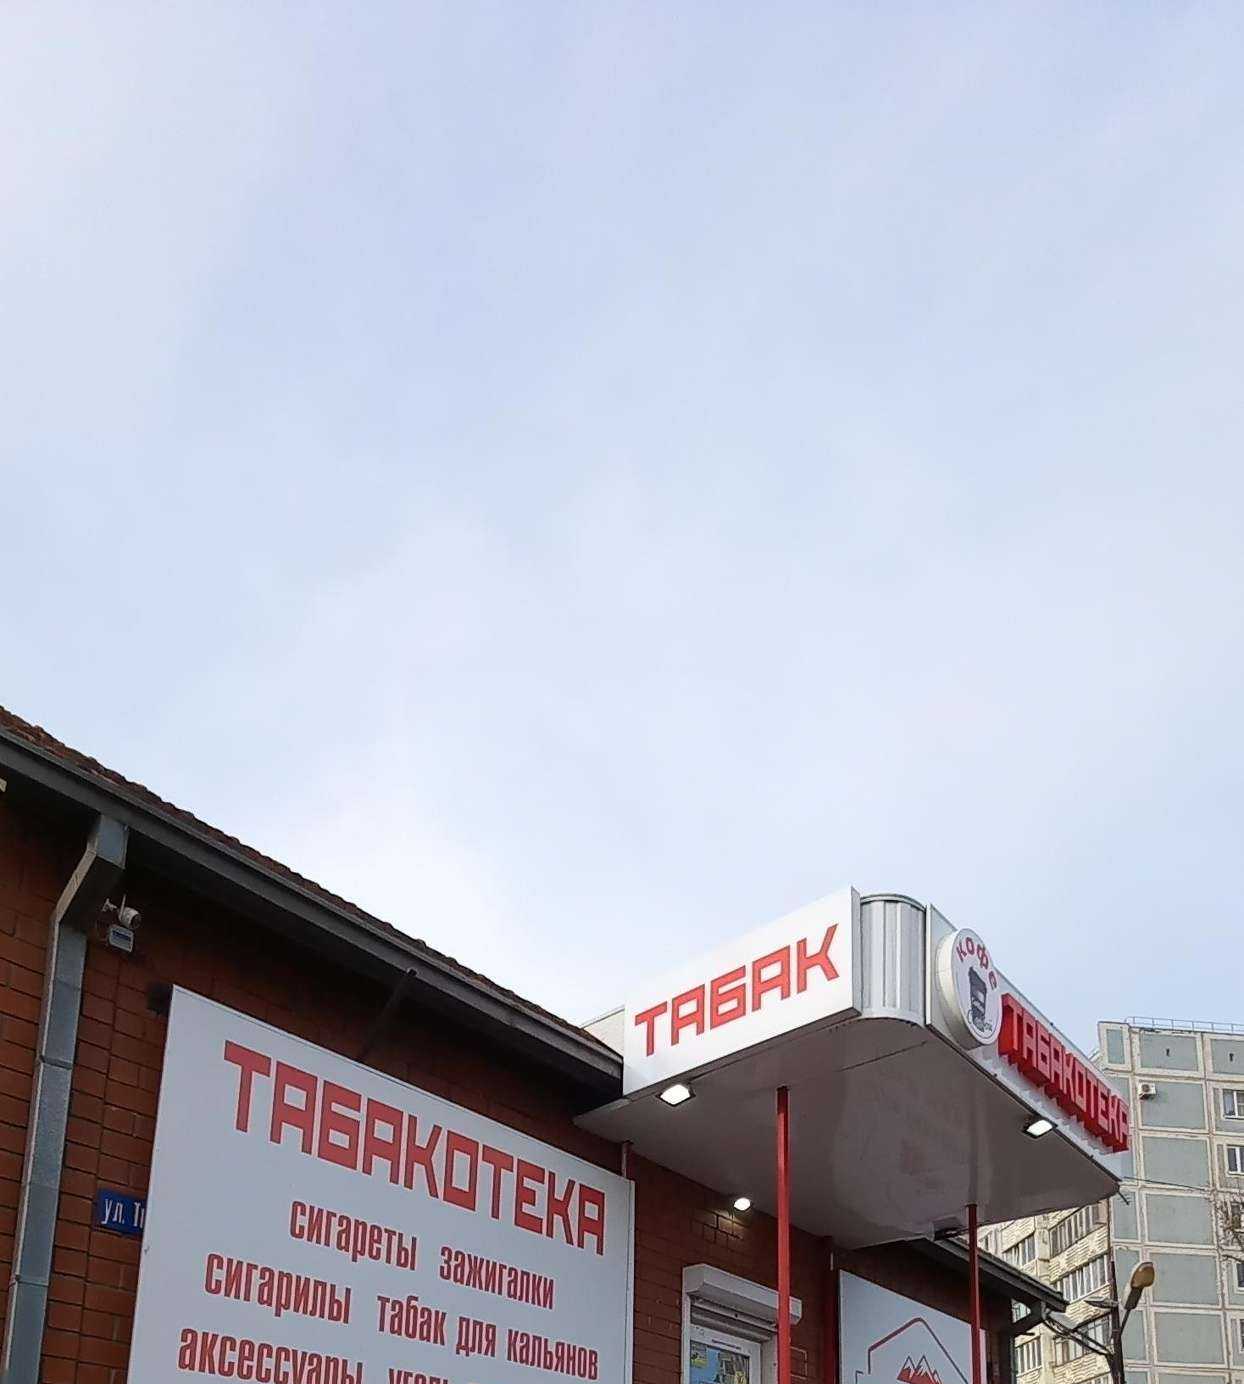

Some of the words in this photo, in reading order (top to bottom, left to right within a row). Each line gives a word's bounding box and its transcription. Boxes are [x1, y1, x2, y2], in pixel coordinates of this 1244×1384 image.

[634, 925, 838, 1055] ТАБАК
[999, 993, 1131, 1150] ТАБАКОТЕКА
[101, 1199, 125, 1224] ул.
[224, 1040, 605, 1255] ТАБАКОТЕКА
[205, 1254, 351, 1324] сигарилы
[378, 1296, 446, 1345] табак
[456, 1317, 496, 1356] для
[507, 1329, 598, 1380] кальянов
[290, 1201, 416, 1270] сигареты
[440, 1247, 554, 1309] зажигалки
